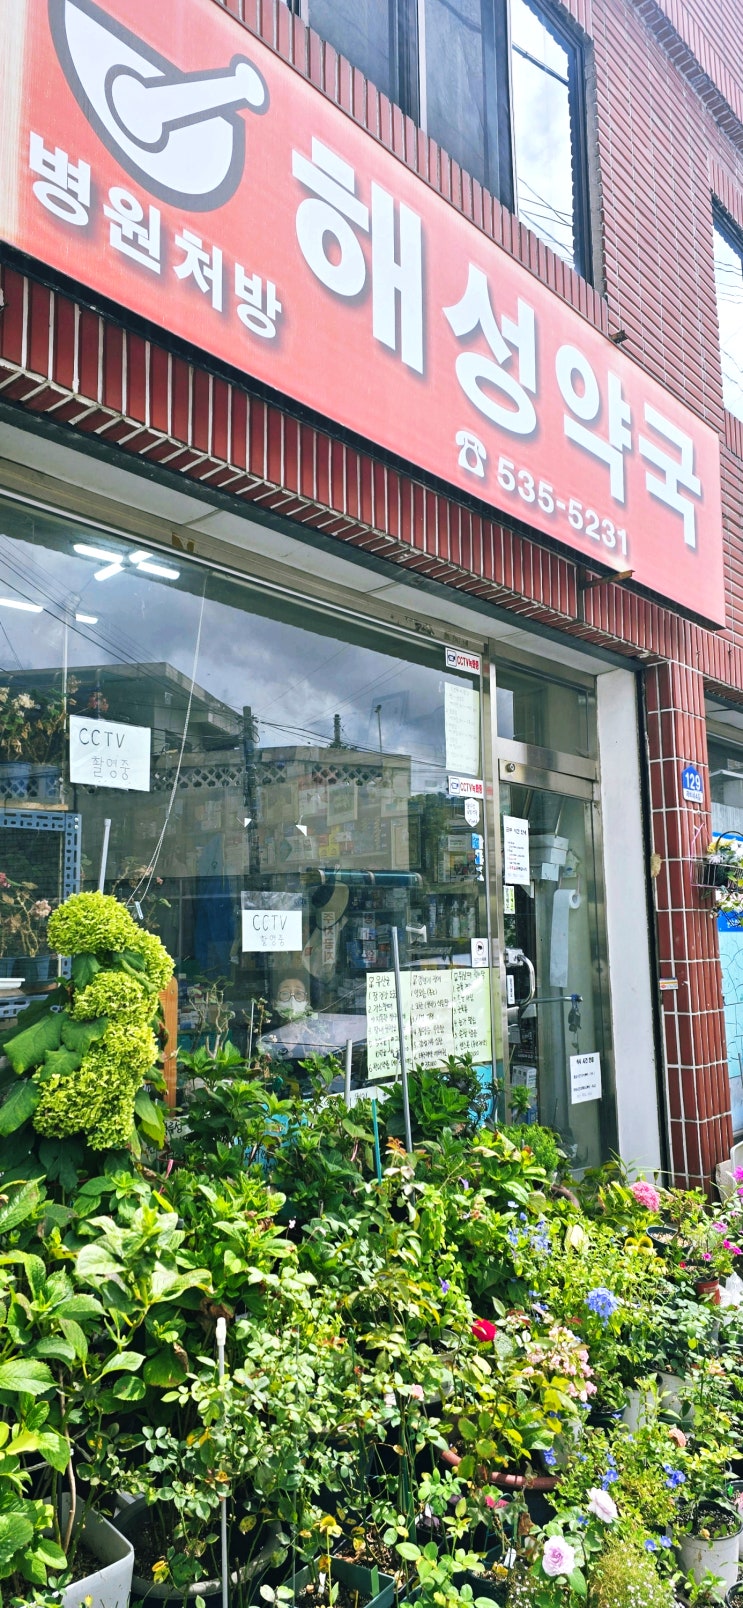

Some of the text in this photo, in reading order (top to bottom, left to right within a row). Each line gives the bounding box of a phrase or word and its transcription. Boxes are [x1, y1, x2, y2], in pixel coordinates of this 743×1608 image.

[29, 131, 282, 340] 병원처방
[291, 136, 703, 550] 해성약국
[497, 458, 630, 557] 535-5231
[79, 727, 125, 748] CCTV
[91, 756, 130, 780] 촬영중
[685, 772, 701, 790] 129
[252, 914, 288, 931] CCTV
